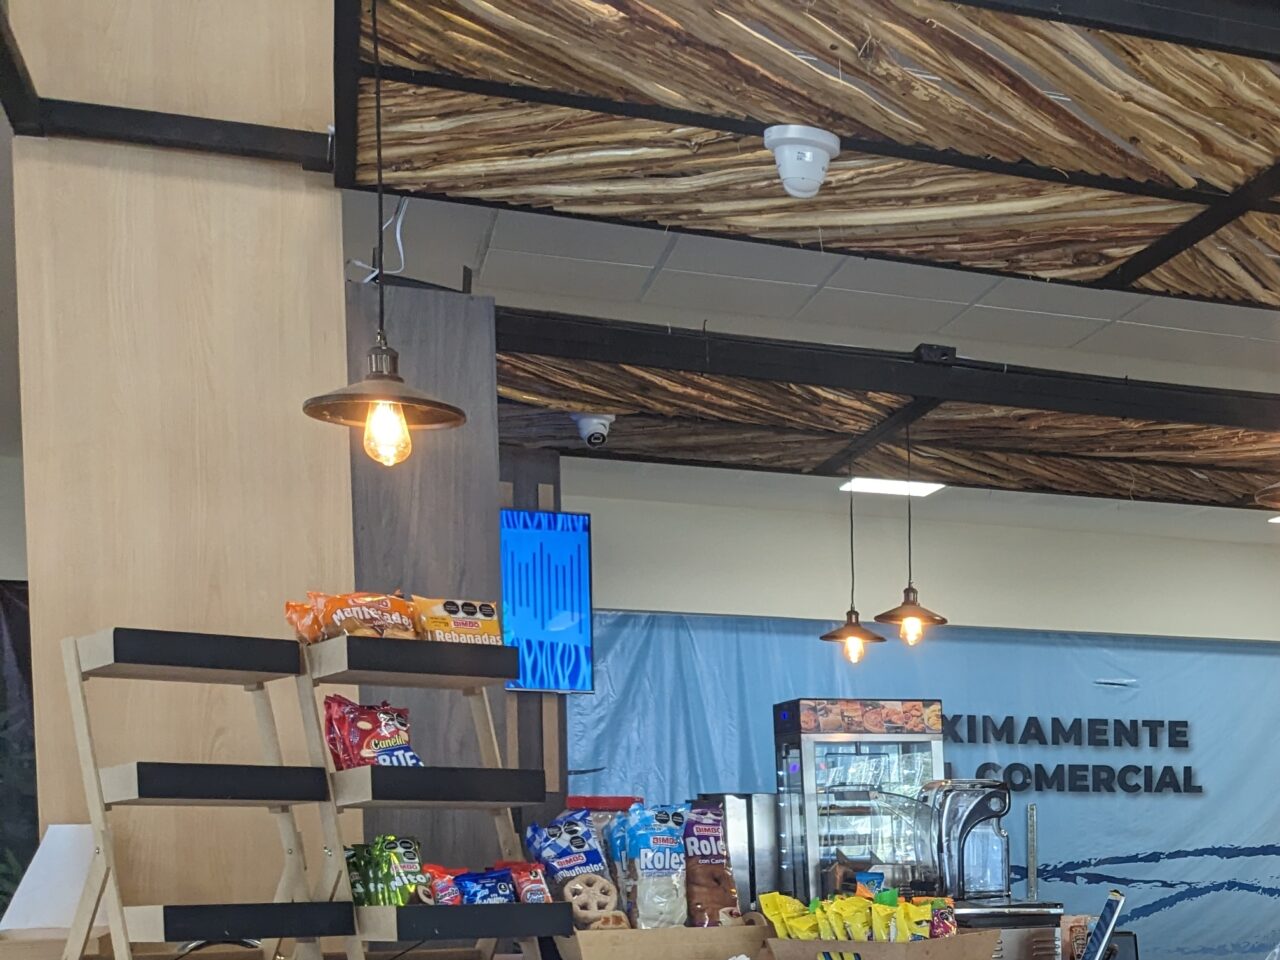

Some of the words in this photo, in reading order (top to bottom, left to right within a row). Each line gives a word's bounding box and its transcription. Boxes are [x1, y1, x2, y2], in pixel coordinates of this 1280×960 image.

[452, 620, 480, 629] BIMBO
[435, 630, 503, 646] Rebanadas
[942, 715, 1189, 748] XIMAMENTE
[378, 750, 424, 767] BITE
[976, 762, 1203, 794] COMERCIAL
[556, 854, 585, 868] BIMBO
[640, 849, 685, 871] Roles
